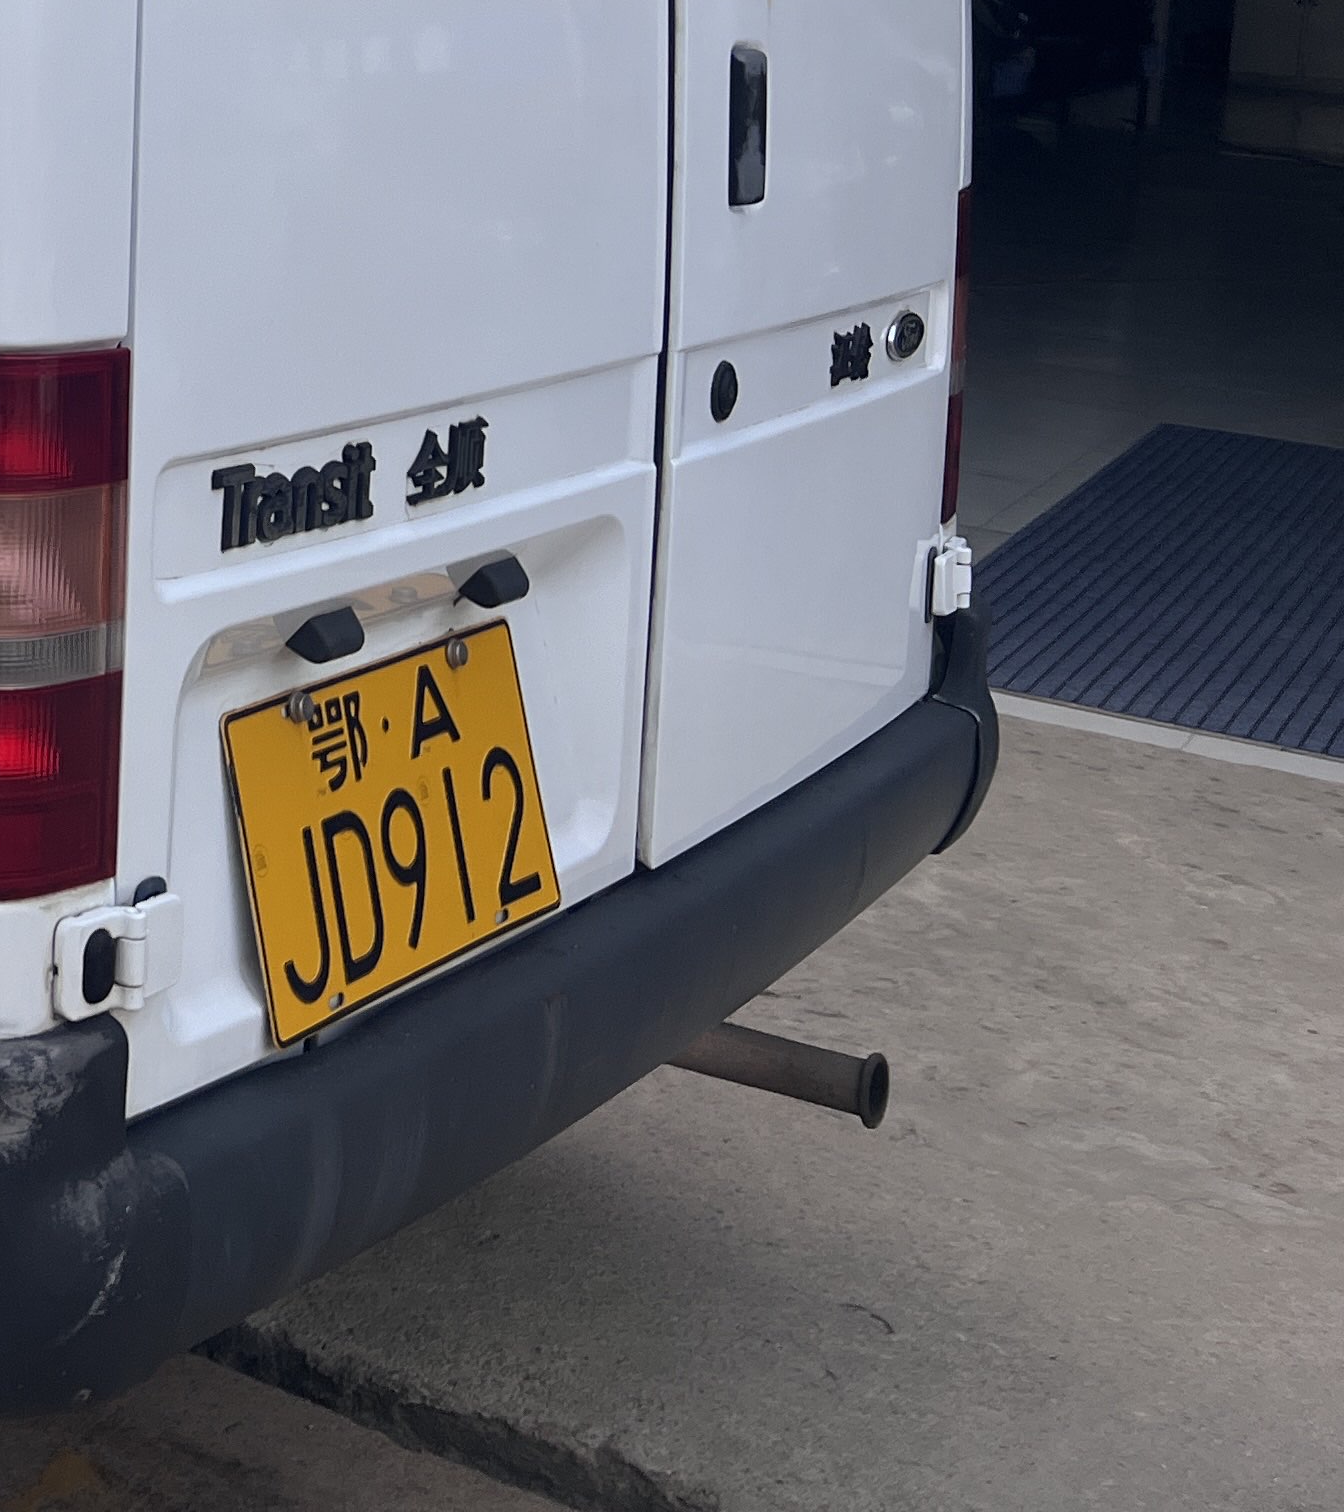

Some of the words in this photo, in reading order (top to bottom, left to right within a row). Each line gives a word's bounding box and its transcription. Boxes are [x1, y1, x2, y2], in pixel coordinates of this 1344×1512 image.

[211, 441, 375, 552] Transit
[405, 416, 489, 507] 全顺
[283, 746, 542, 1004] JD912
